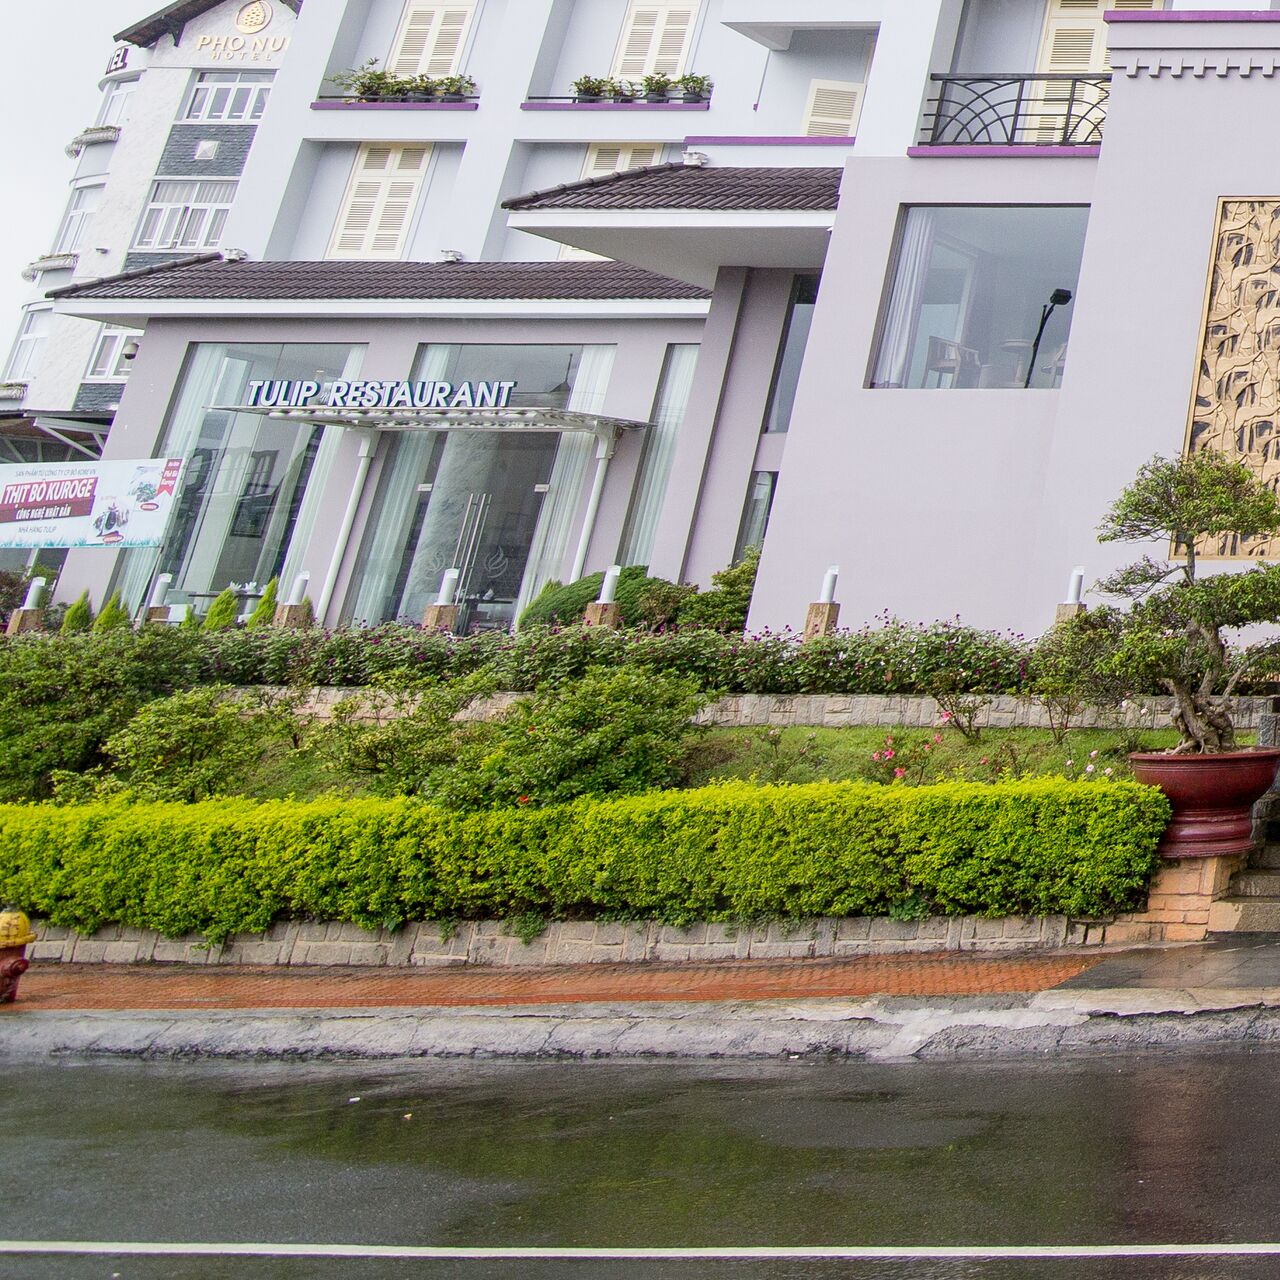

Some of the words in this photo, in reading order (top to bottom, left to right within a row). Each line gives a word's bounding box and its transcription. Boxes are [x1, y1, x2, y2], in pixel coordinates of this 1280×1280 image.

[197, 35, 246, 51] PHO
[211, 50, 272, 61] HOTEL
[247, 380, 321, 406] TULIP
[327, 381, 517, 407] RESTAURANT
[4, 484, 31, 508] THỊT
[28, 479, 47, 502] BÒ
[46, 479, 95, 501] KUROGE
